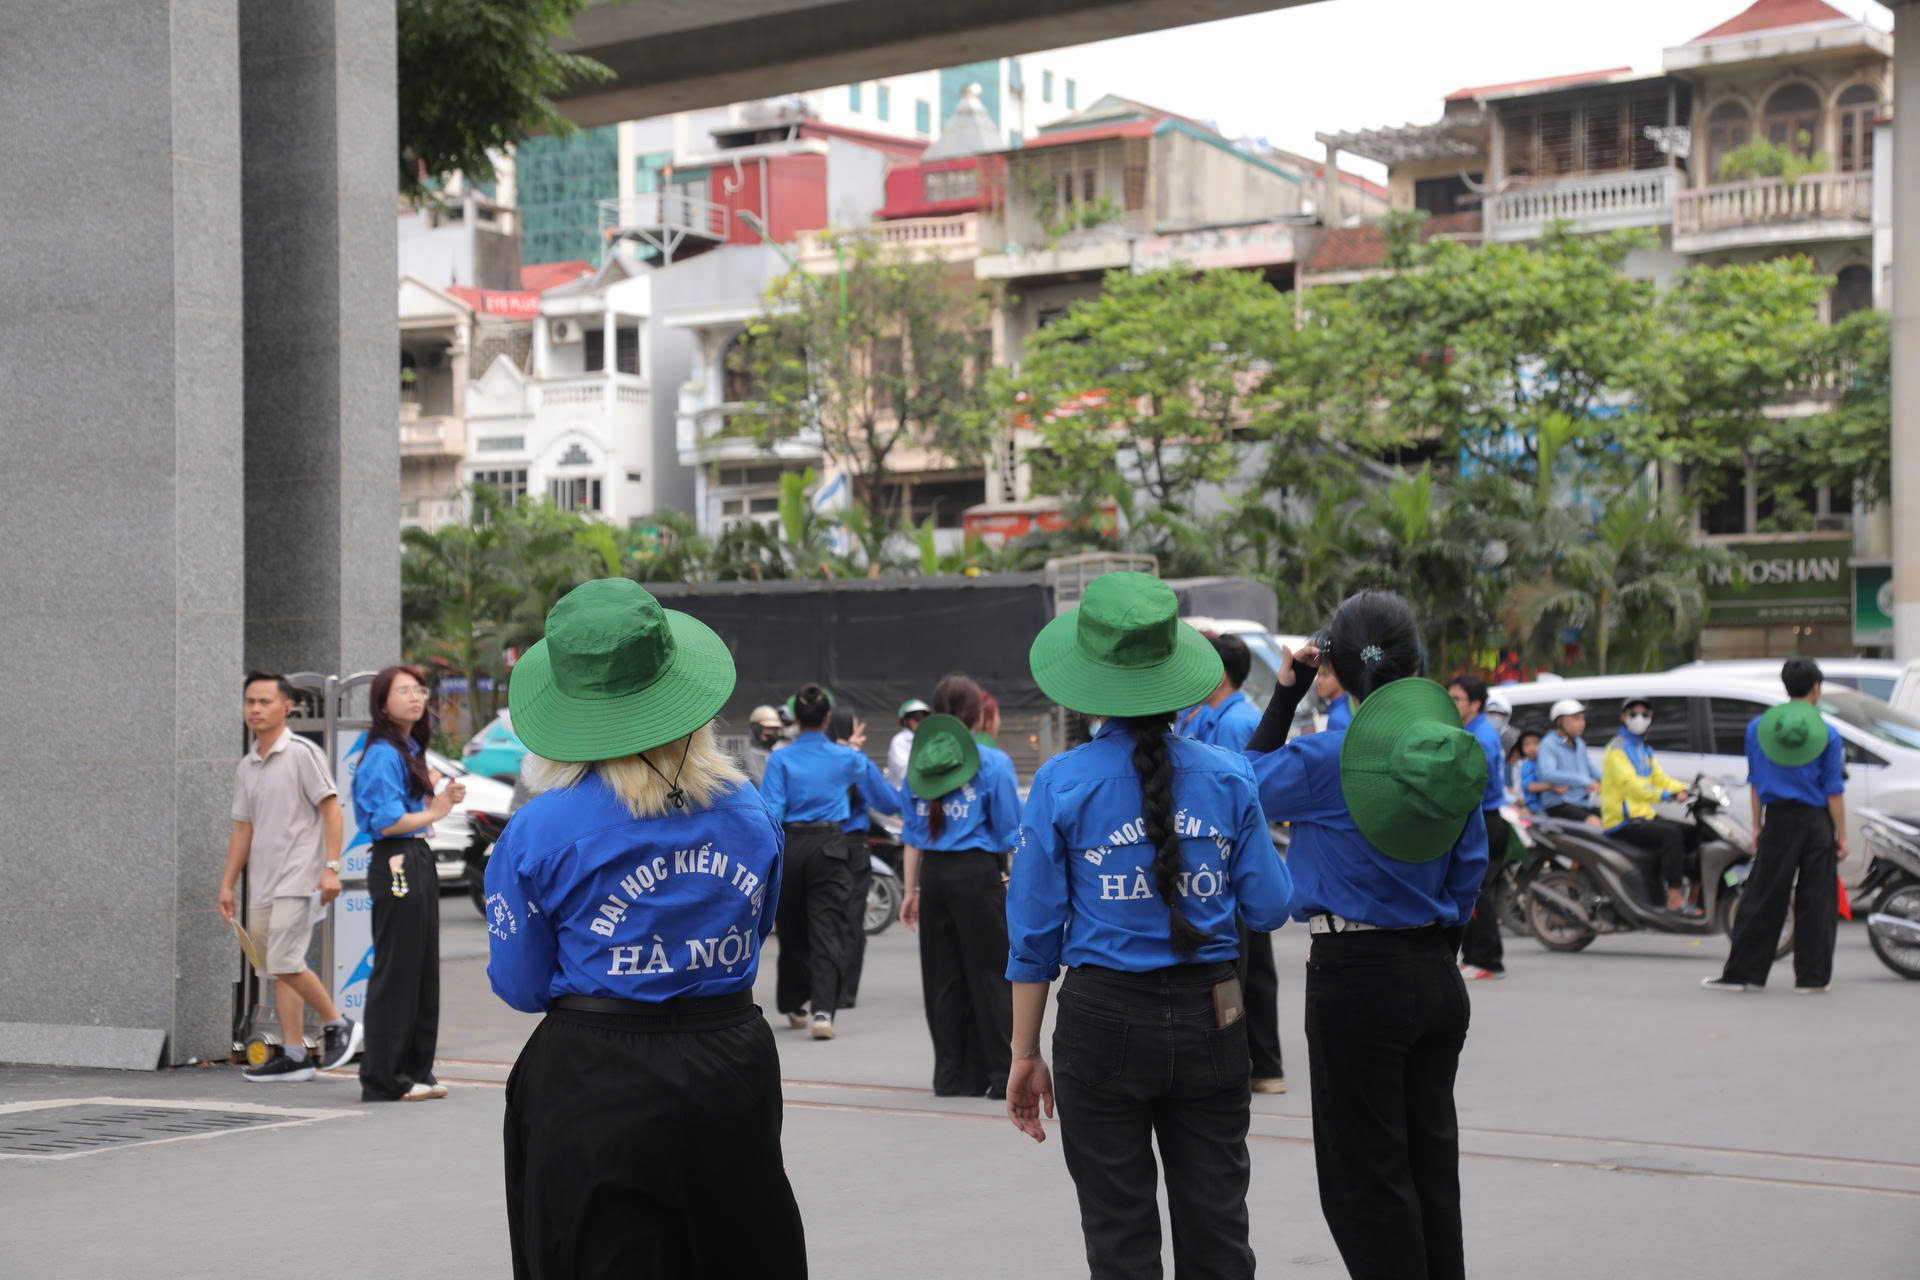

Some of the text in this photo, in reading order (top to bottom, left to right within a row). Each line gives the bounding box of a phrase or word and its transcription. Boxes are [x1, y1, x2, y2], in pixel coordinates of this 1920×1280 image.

[1174, 808, 1202, 838] ẾN
[589, 894, 629, 938] ĐẠI
[620, 857, 668, 900] HỌC
[674, 842, 728, 878] KIẾN
[1099, 866, 1154, 900] HÀ
[607, 925, 752, 976] HÀ NỘI
[345, 993, 362, 1009] SU
